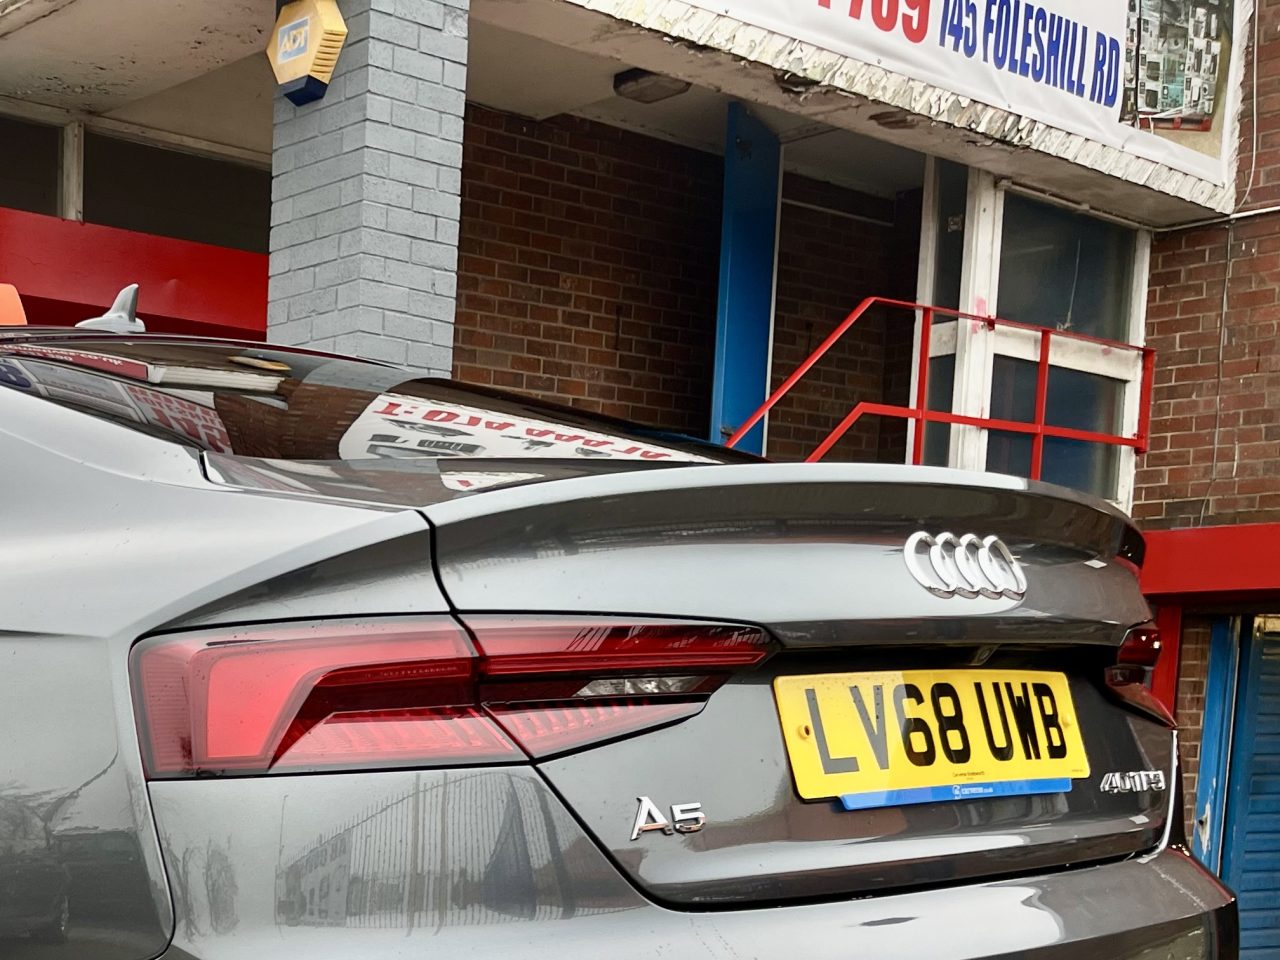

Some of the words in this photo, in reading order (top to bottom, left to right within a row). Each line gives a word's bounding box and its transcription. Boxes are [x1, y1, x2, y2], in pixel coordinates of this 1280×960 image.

[982, 0, 1088, 98] FOLESHILL
[1089, 31, 1121, 108] RD
[805, 683, 971, 776] LV68
[974, 681, 1068, 761] UWB
[630, 796, 706, 841] A5
